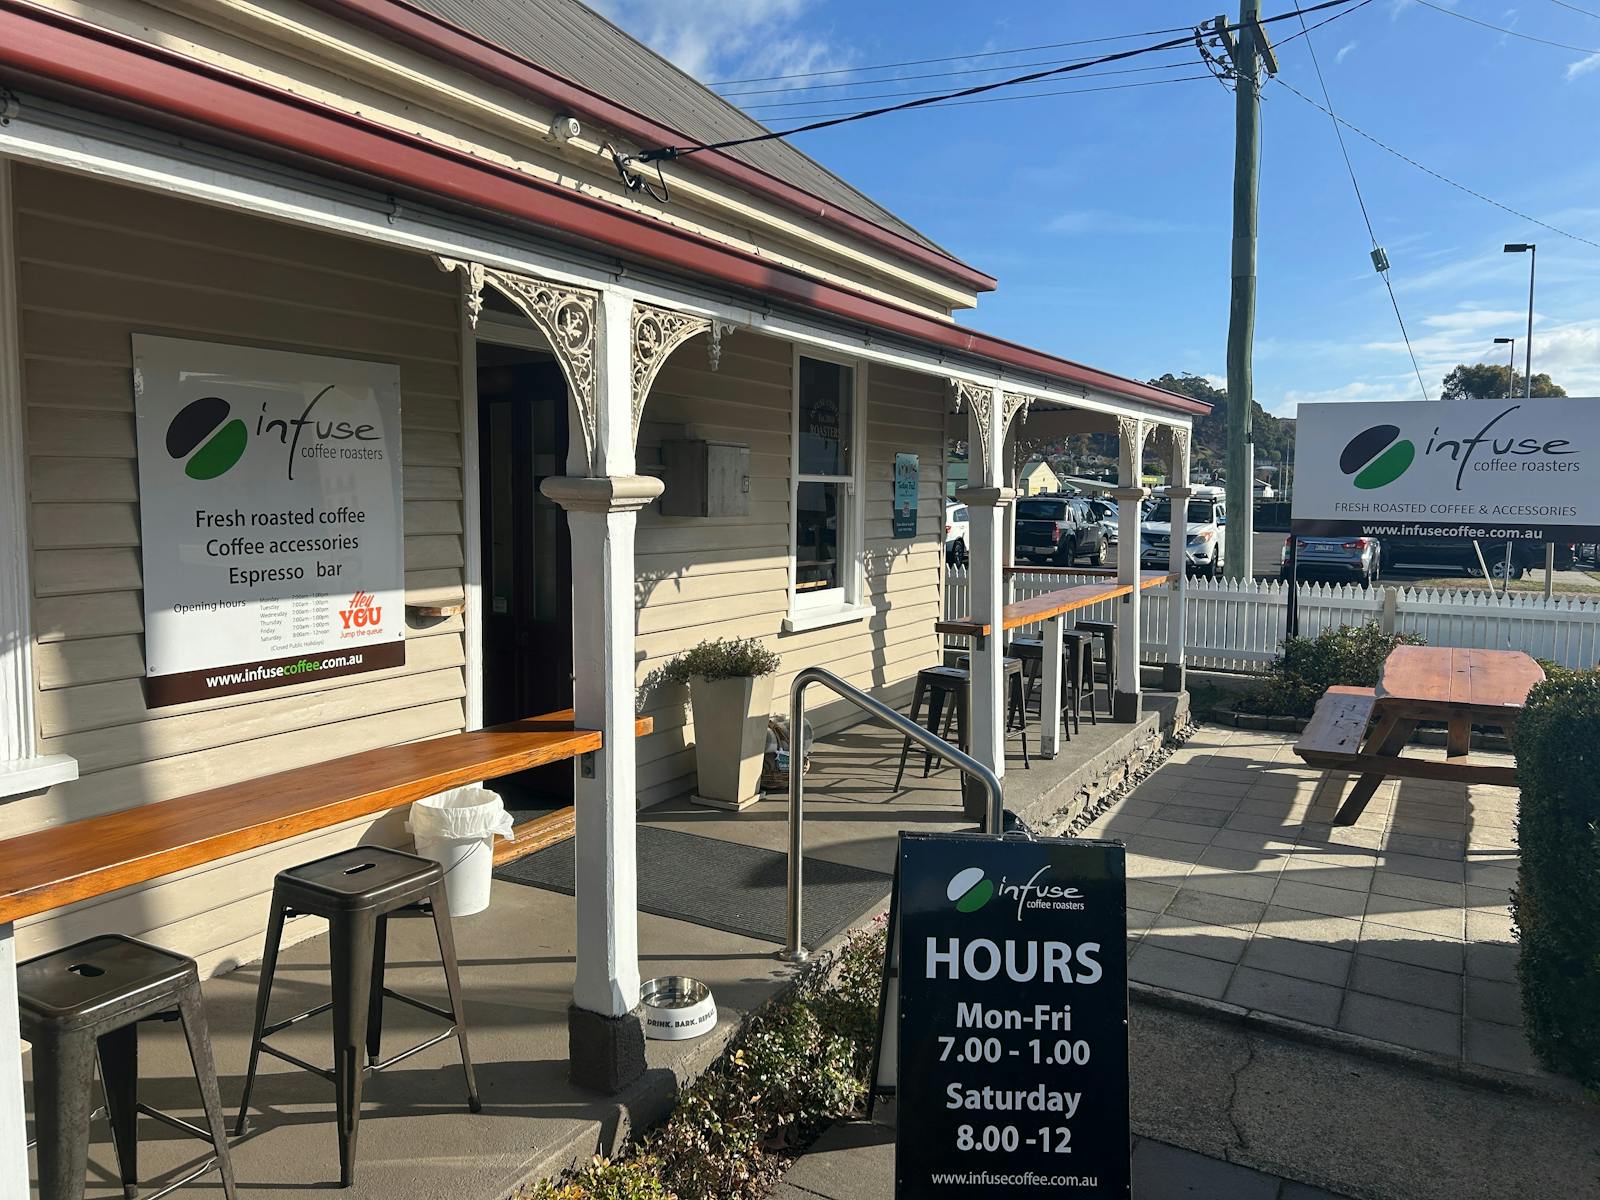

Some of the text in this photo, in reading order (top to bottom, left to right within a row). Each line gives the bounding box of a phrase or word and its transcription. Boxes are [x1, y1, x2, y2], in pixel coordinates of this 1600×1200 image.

[256, 385, 382, 480] infuse
[301, 445, 383, 460] coffee roasters
[1425, 405, 1582, 491] infuse
[1474, 458, 1580, 472] coffee roasters
[196, 507, 366, 528] Fresh roasted coffee
[1335, 502, 1577, 517] FRESH ROASTED COFFEE & ACCESSORIES
[1362, 524, 1543, 540] www.infusecoffee.com.au
[206, 535, 359, 557] Coffee accessories
[229, 562, 342, 587] Espresso bar
[173, 599, 246, 616] Opening hours
[349, 590, 375, 610] Hey
[338, 606, 382, 629] YOU
[340, 628, 383, 639] Jump the queue
[206, 653, 363, 687] www.infusecoffee.com.au
[998, 865, 1085, 921] infuse
[1026, 900, 1085, 911] coffee roasters
[926, 936, 1103, 985] HOURS
[956, 1002, 1071, 1031] Mon-Fri
[946, 1082, 1081, 1119] Saturday
[931, 1171, 1098, 1187] www.infusecoffee.com.au
